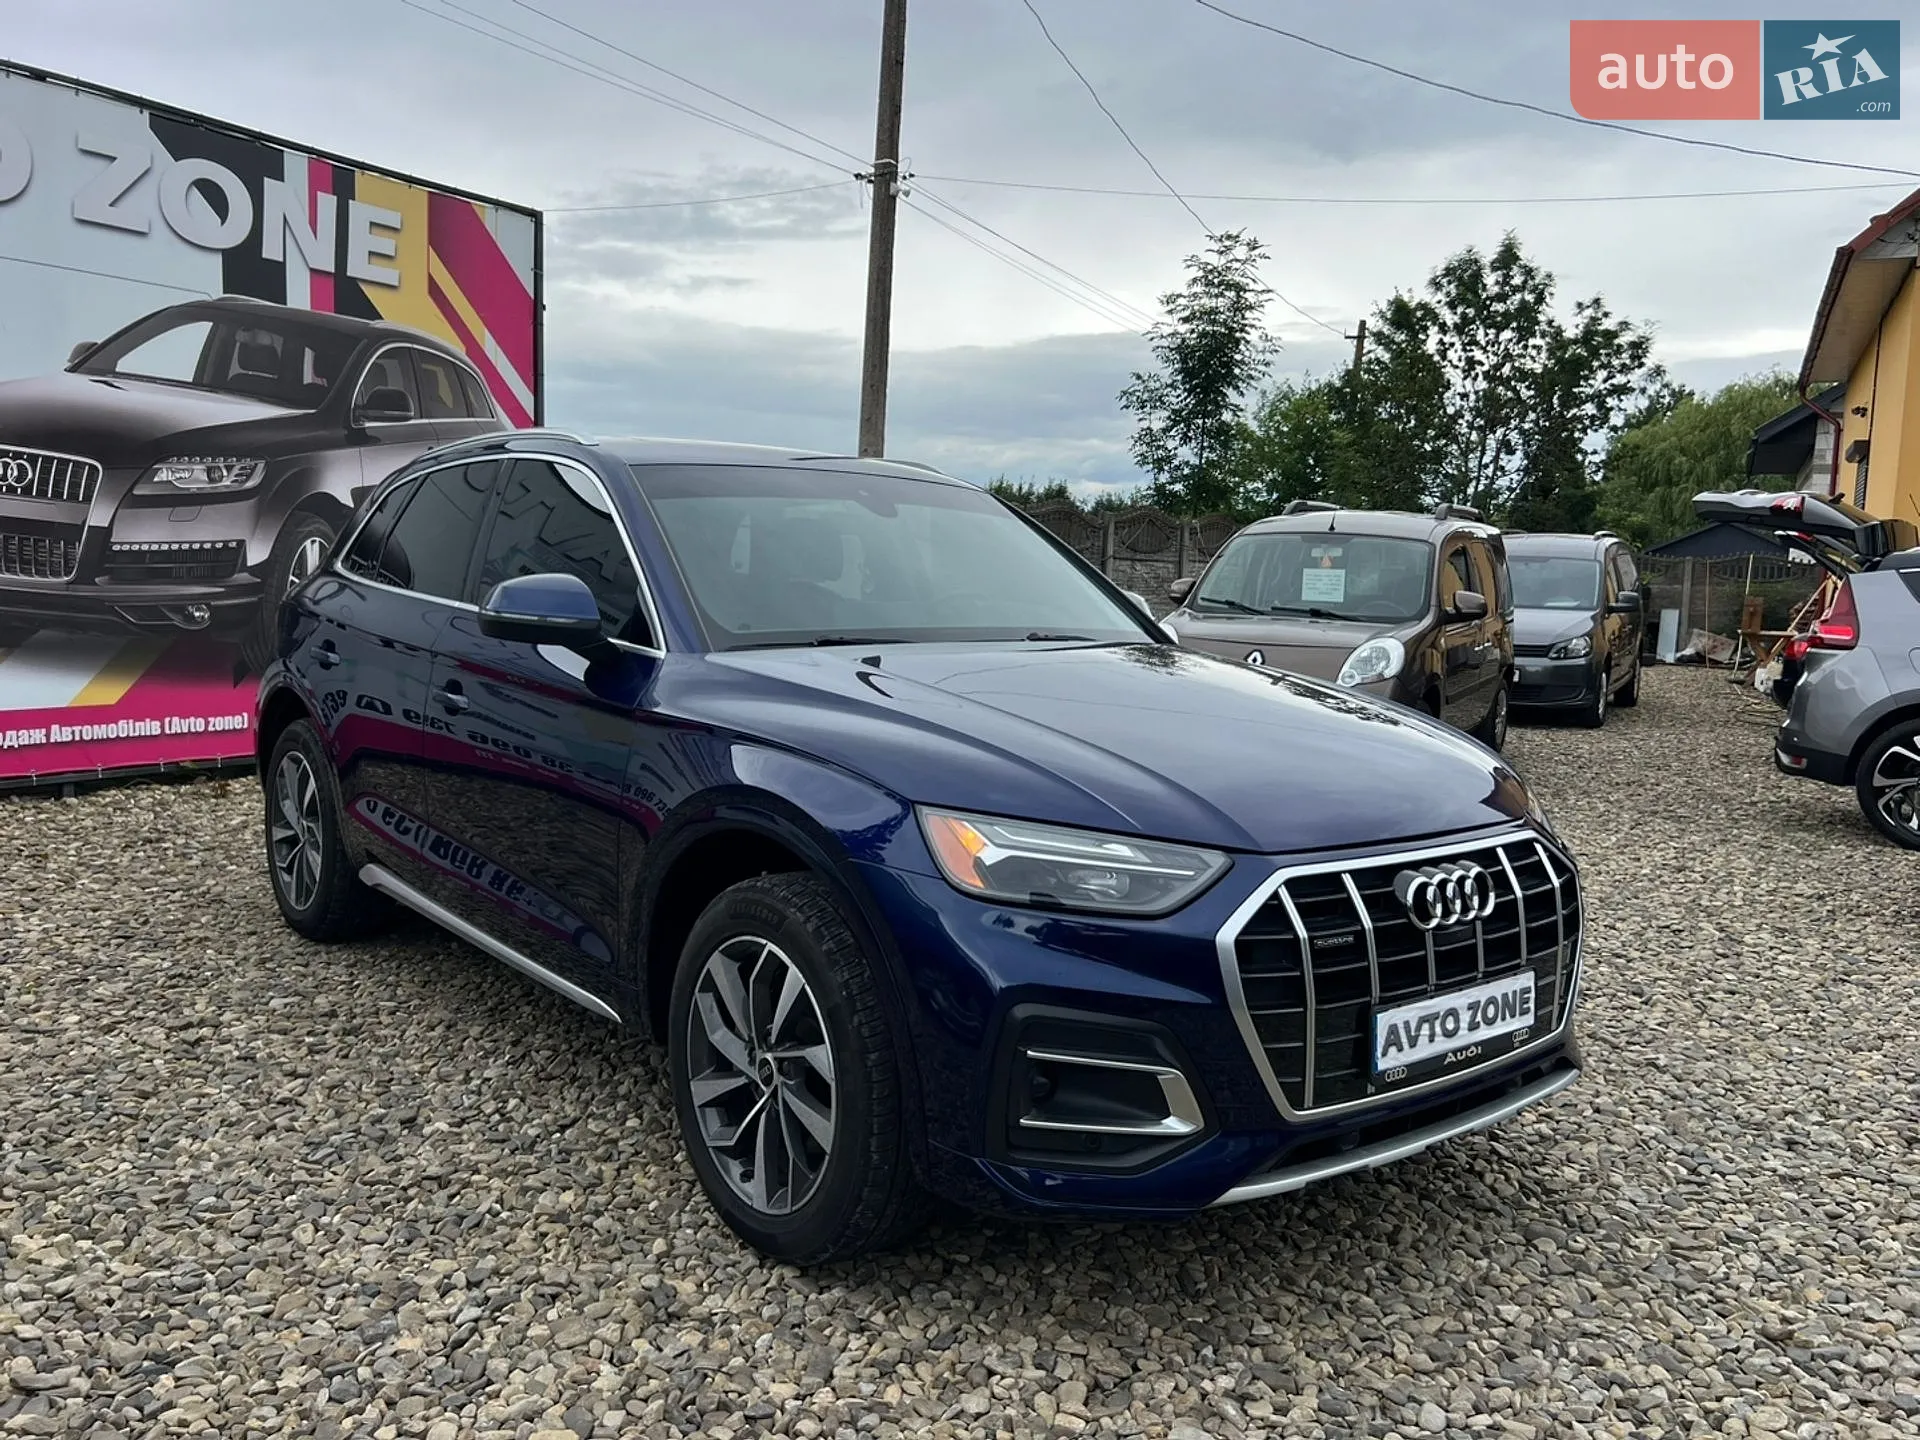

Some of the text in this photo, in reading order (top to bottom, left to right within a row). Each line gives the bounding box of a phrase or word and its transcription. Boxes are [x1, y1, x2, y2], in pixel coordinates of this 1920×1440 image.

[72, 128, 402, 288] ZONE
[50, 719, 161, 743] Автомобілів
[1382, 986, 1532, 1057] AVTO ZONE
[1443, 1046, 1482, 1065] Audi
